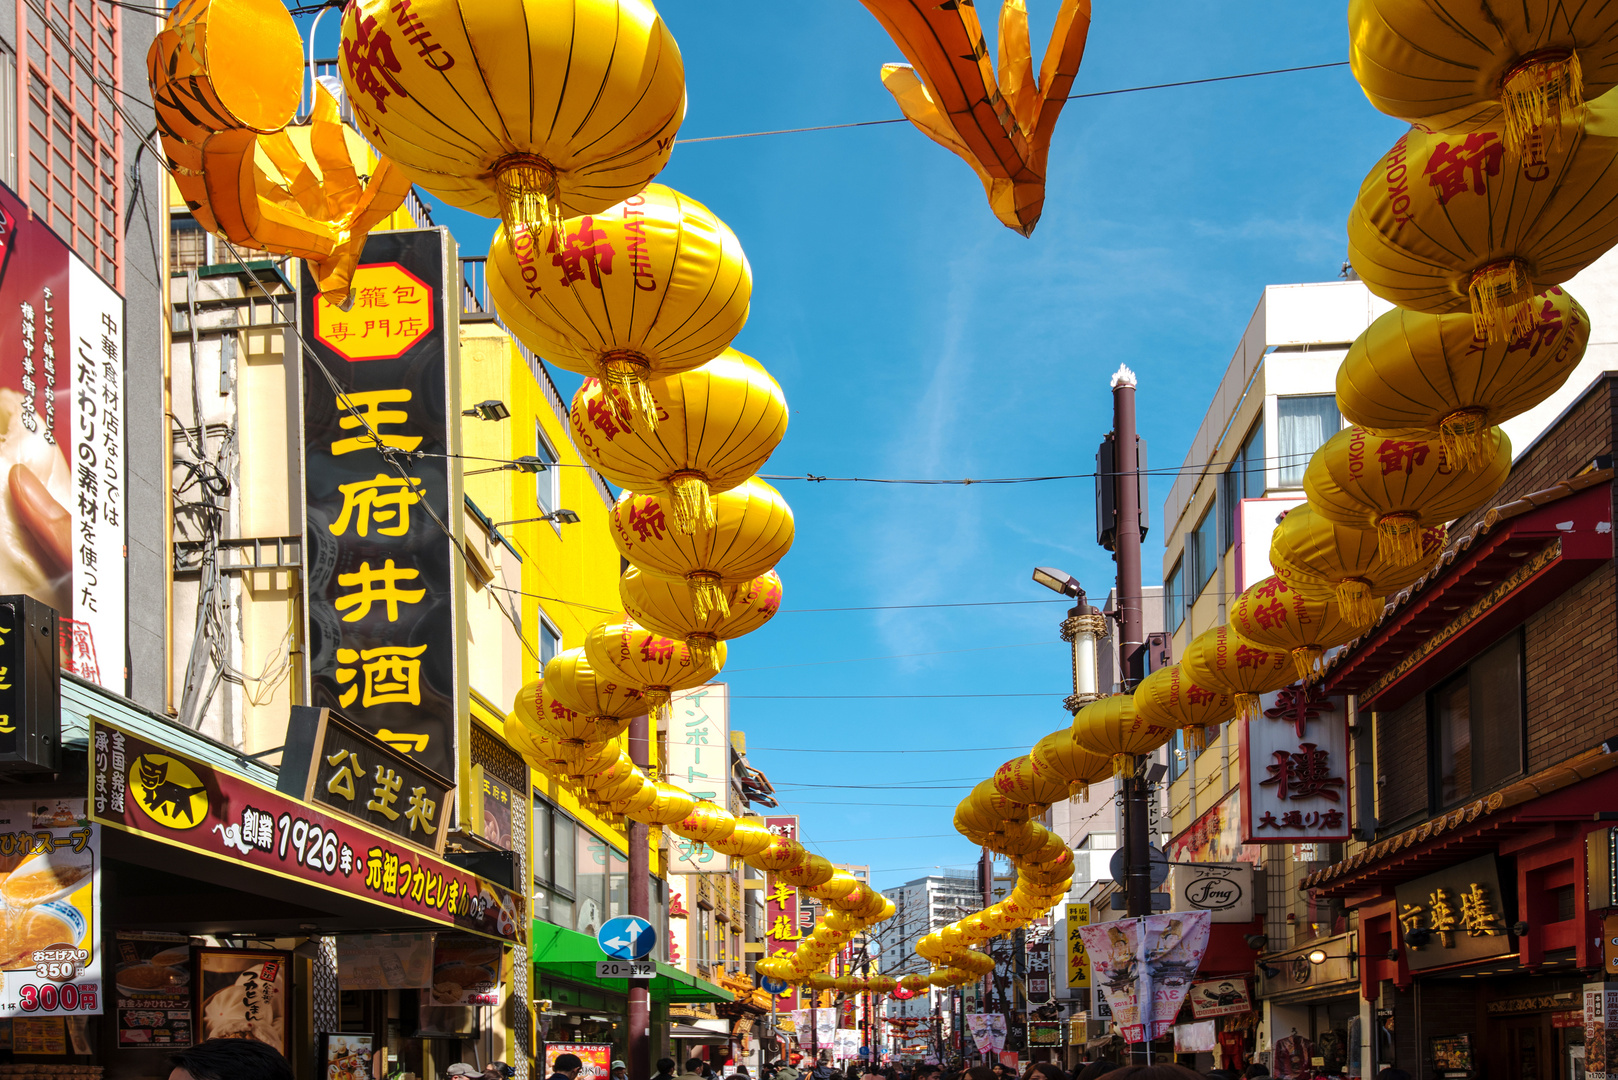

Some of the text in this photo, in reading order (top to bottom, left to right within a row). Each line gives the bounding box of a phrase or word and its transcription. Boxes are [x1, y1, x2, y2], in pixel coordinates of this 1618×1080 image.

[325, 284, 422, 309] 籠包
[325, 317, 423, 343] 専門店
[43, 285, 57, 445] テレビや雑誌でおなじみ
[101, 311, 120, 528] 中華食材店ならでは
[77, 336, 98, 613] こだわりの素材を使った
[1216, 625, 1228, 672] YOKOHAMA
[95, 730, 109, 814] 承ります
[111, 730, 126, 814] 全国発送
[685, 690, 709, 784] インポート
[1257, 808, 1345, 830] 大通り店
[33, 949, 89, 962] おこげ入り
